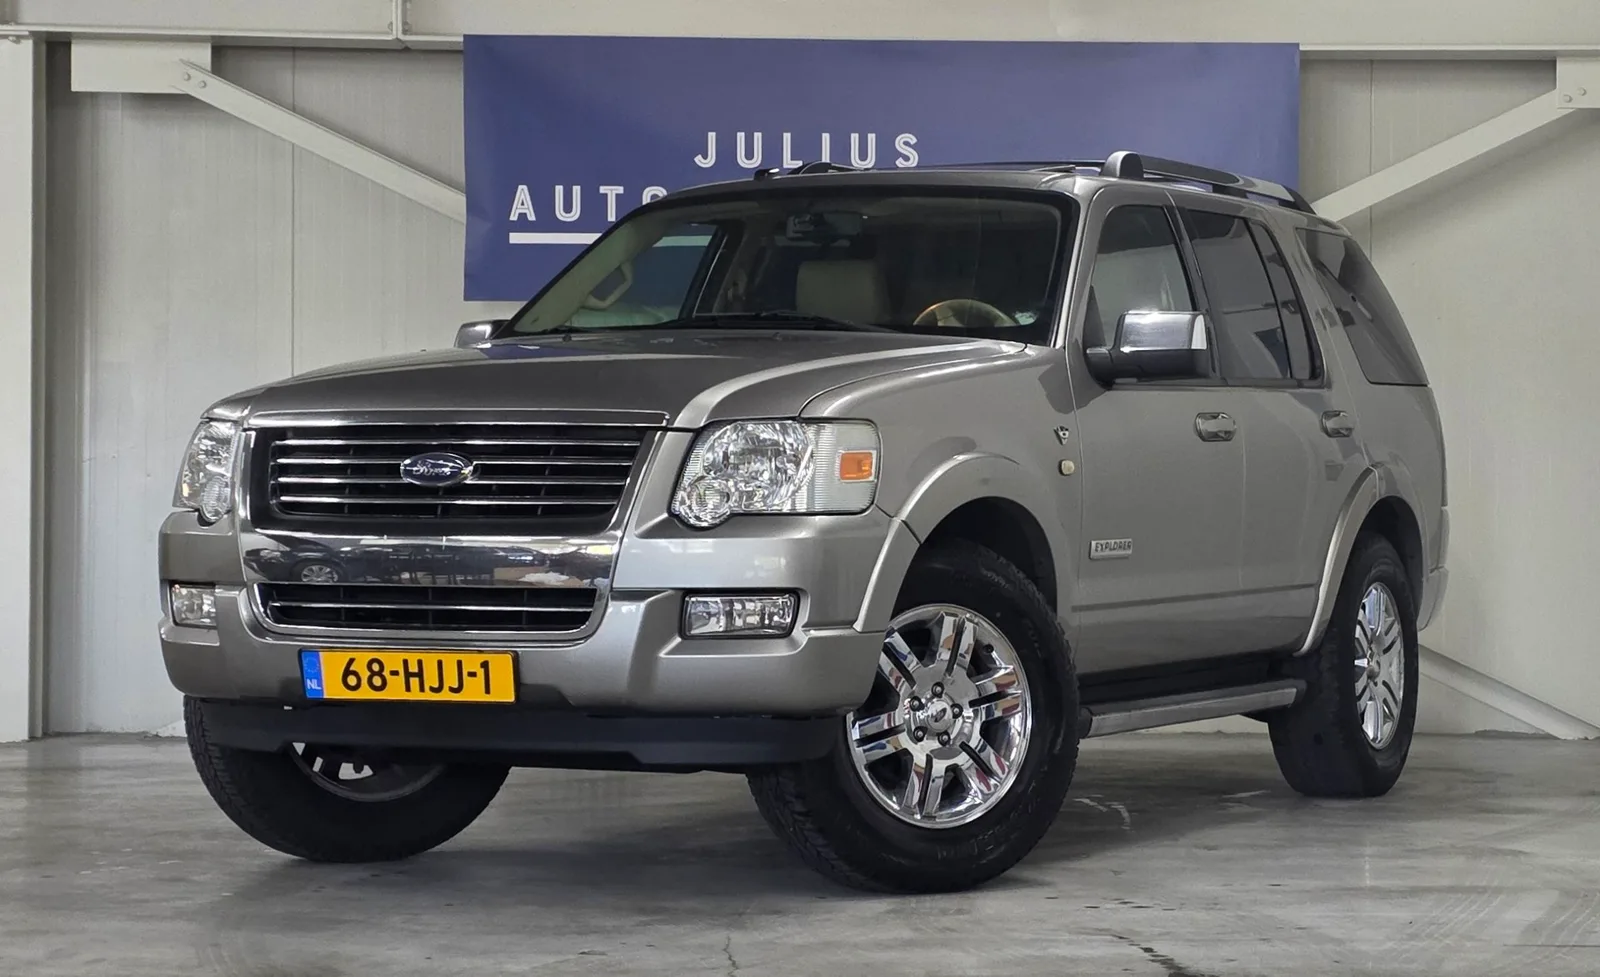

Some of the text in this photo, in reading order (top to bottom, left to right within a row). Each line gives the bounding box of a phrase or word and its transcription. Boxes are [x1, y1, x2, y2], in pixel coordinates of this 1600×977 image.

[694, 131, 919, 168] JULIUS
[1094, 540, 1132, 552] EXPLORER
[306, 678, 321, 690] NL
[341, 657, 491, 695] 68-HJJ-1
